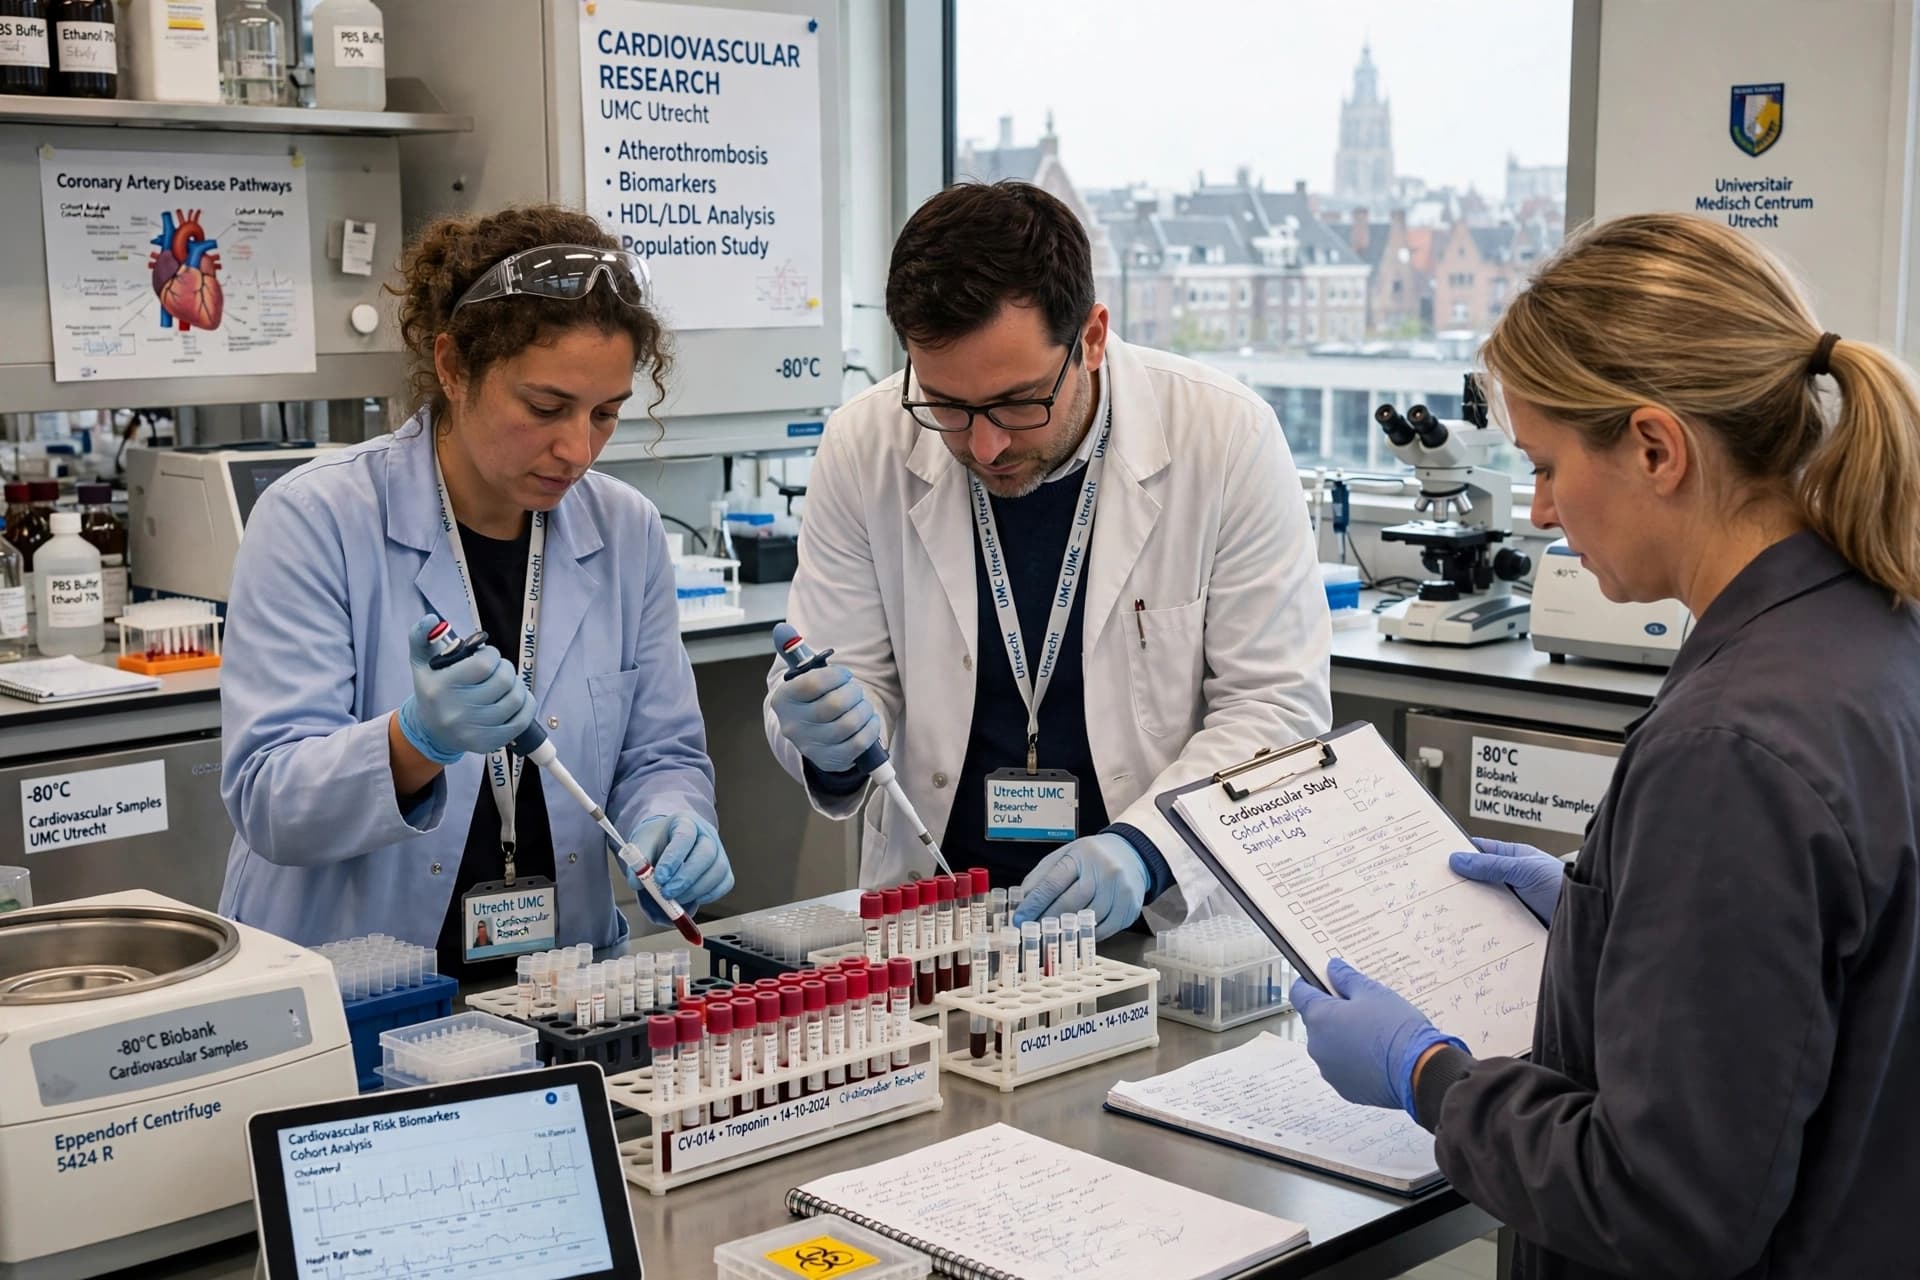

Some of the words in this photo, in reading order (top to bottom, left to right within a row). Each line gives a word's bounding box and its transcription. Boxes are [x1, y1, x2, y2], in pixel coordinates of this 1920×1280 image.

[63, 28, 102, 42] Ethanol
[598, 29, 801, 68] CARDIOVASCULAR
[600, 64, 721, 95] RESEARCH
[600, 98, 643, 121] UMC
[648, 101, 710, 124] Utrecht
[618, 139, 769, 166] Atherothrombosis
[56, 173, 123, 192] Coronary
[126, 174, 171, 193] Artery
[173, 175, 226, 192] Disease
[229, 177, 293, 196] Pathways
[619, 171, 717, 194] Biomarkers
[1714, 177, 1794, 194] Universitair
[620, 202, 702, 228] HDL/LDL
[706, 204, 776, 230] Analysis
[1695, 195, 1751, 211] Medisch
[1754, 196, 1814, 210] Centrum
[1727, 213, 1779, 229] Utrecht
[621, 234, 717, 260] Population
[721, 235, 770, 260] Study
[775, 357, 822, 379] -80°C
[52, 580, 72, 591] PBS
[993, 580, 1010, 609] UMC
[1056, 578, 1073, 609] UMC
[1476, 745, 1519, 767] -80°C
[491, 755, 506, 788] UMC
[1475, 766, 1518, 784] Biobank
[26, 780, 72, 803] -80°C
[993, 785, 1035, 799] Utrecht
[1037, 787, 1065, 799] UMC
[1219, 789, 1304, 828] Cardiovascular
[1302, 775, 1339, 796] Study
[1474, 782, 1549, 806] Cardiovascular
[1551, 794, 1596, 814] Samples
[29, 804, 113, 829] Cardiovascular
[116, 796, 163, 815] Samples
[993, 801, 1038, 812] Researcher
[993, 814, 1007, 824] CV
[1008, 814, 1023, 824] Lab
[1474, 799, 1501, 815] UMC
[1503, 803, 1542, 822] Utrecht
[29, 828, 60, 847] UMC
[63, 822, 108, 841] Utrecht
[1230, 820, 1268, 842] Cohort
[1270, 804, 1313, 827] Analysis
[1241, 835, 1283, 856] Sample
[1281, 825, 1307, 839] Log
[473, 900, 515, 916] Utrecht
[517, 895, 545, 910] UMC
[117, 1033, 158, 1056] -80°C
[160, 1022, 217, 1048] Biobank
[1020, 1033, 1051, 1054] CV-021
[1060, 1019, 1097, 1043] LDL/HDL
[1105, 1003, 1150, 1029] 14-10-2024
[109, 1050, 198, 1081] Cardiovascular
[199, 1038, 249, 1062] Samples
[54, 1117, 139, 1154] Eppendorf
[142, 1101, 223, 1131] Centrifuge
[288, 1124, 370, 1146] Cardiovascular
[372, 1119, 396, 1132] Risk
[399, 1110, 461, 1129] Biomarkers
[678, 1128, 716, 1151] CV-014
[725, 1114, 770, 1138] Troponin
[779, 1095, 831, 1123] 14-10-2024
[57, 1150, 98, 1173] 5424
[102, 1146, 114, 1161] R
[290, 1146, 328, 1162] Cohort
[330, 1138, 373, 1155] Analysis
